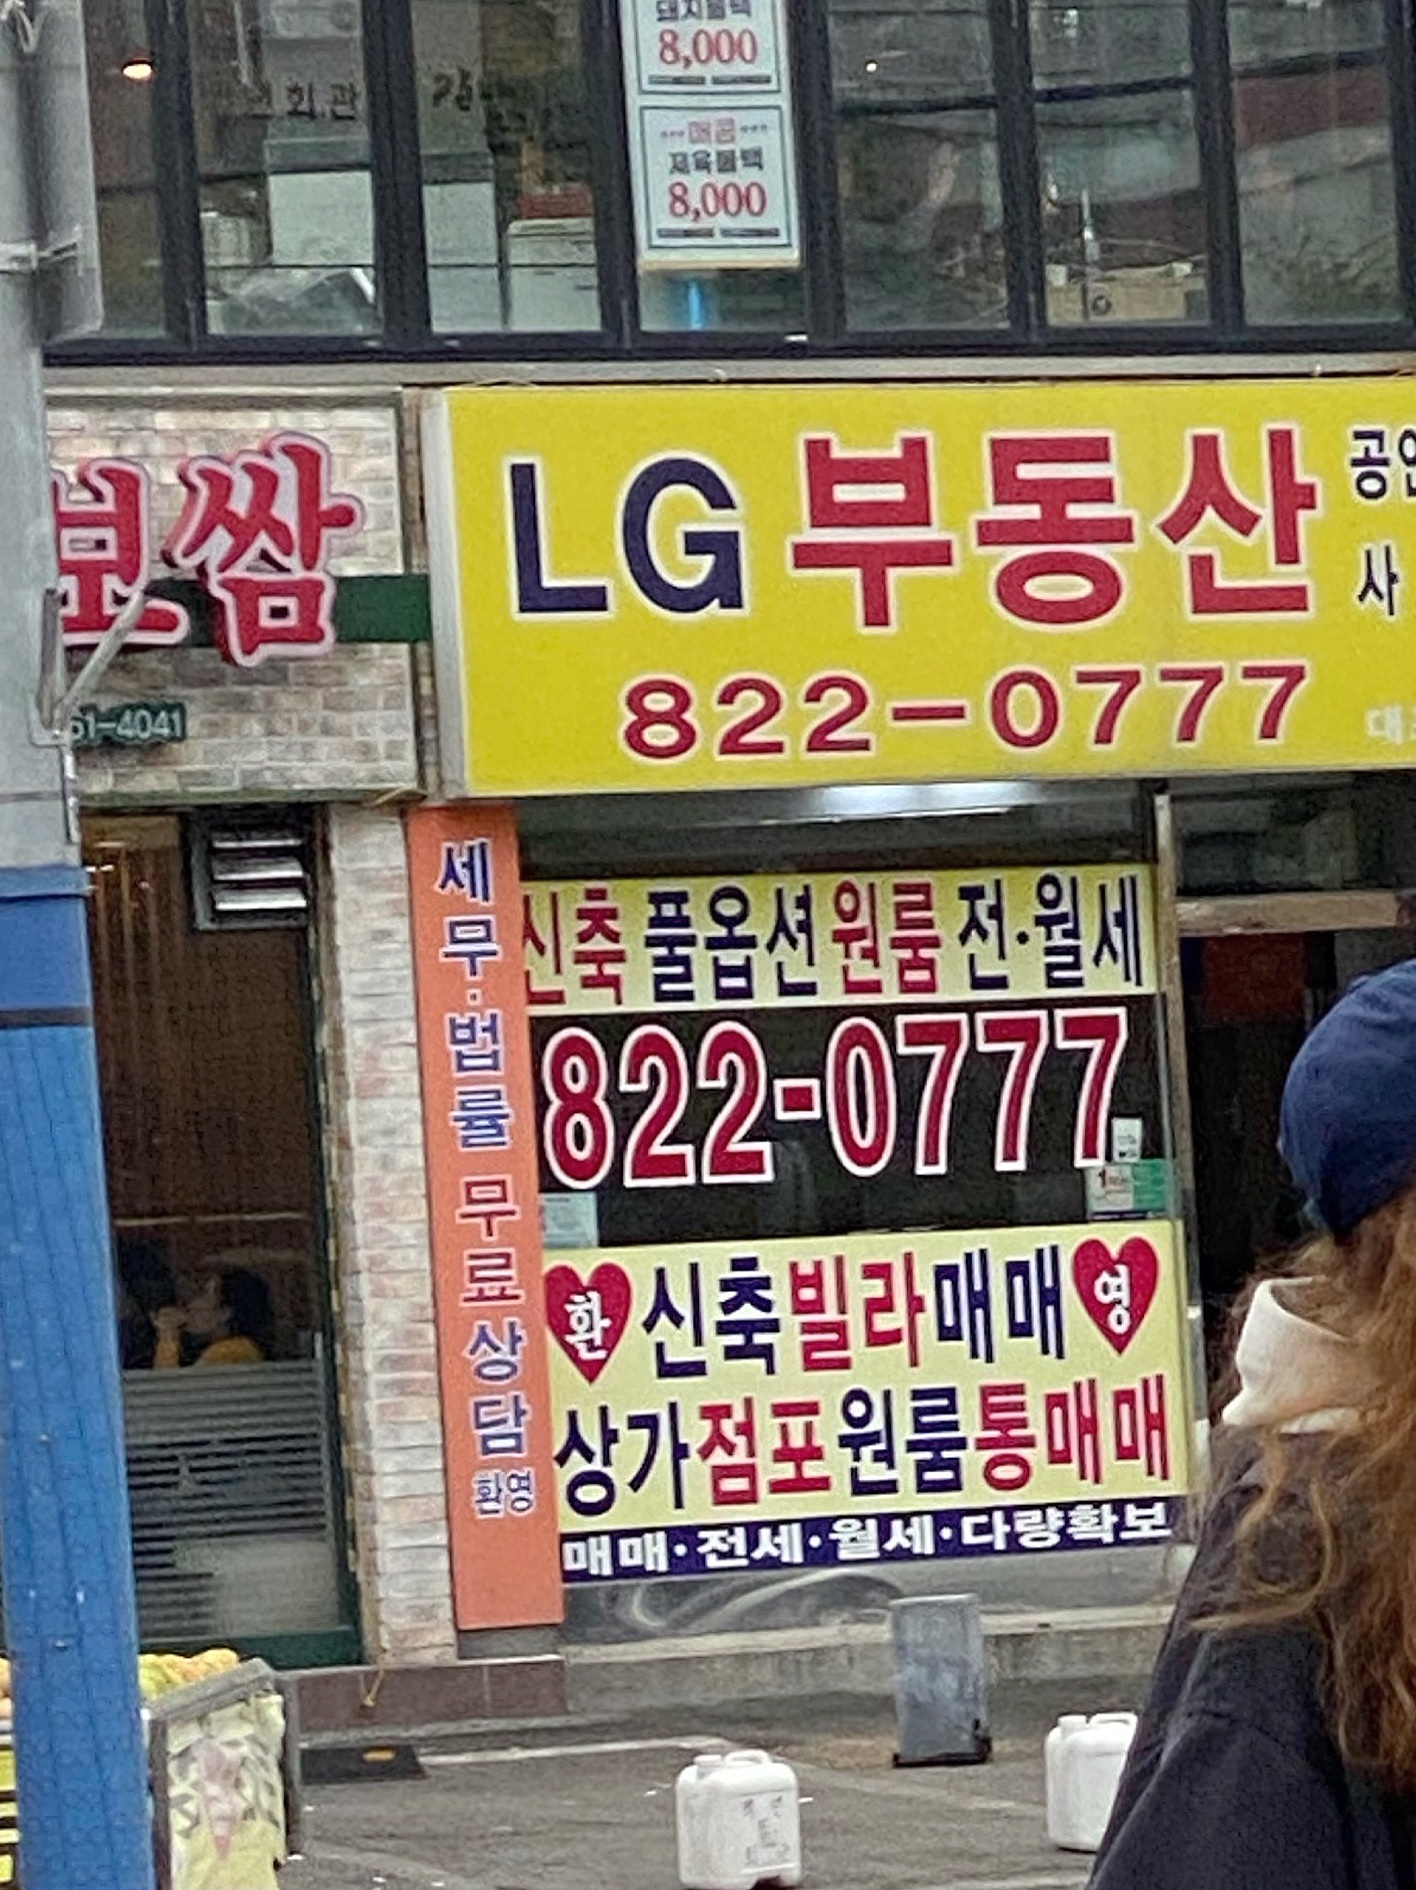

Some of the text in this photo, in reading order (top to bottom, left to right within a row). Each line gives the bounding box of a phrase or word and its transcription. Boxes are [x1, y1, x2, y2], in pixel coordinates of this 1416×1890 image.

[659, 28, 758, 69] 8,000
[668, 181, 767, 222] 8,000
[50, 430, 368, 668] 보쌈
[505, 454, 748, 617] LG
[789, 427, 1321, 630] 부동산
[621, 661, 1311, 761] 822-0777
[522, 884, 628, 1006] 신축
[643, 882, 819, 1005] 풀옵션
[832, 879, 943, 996] 원룸
[540, 1006, 1129, 1191] 822-0777
[563, 1288, 611, 1361] 환
[1094, 1262, 1137, 1338] 영
[473, 1467, 535, 1519] 환영
